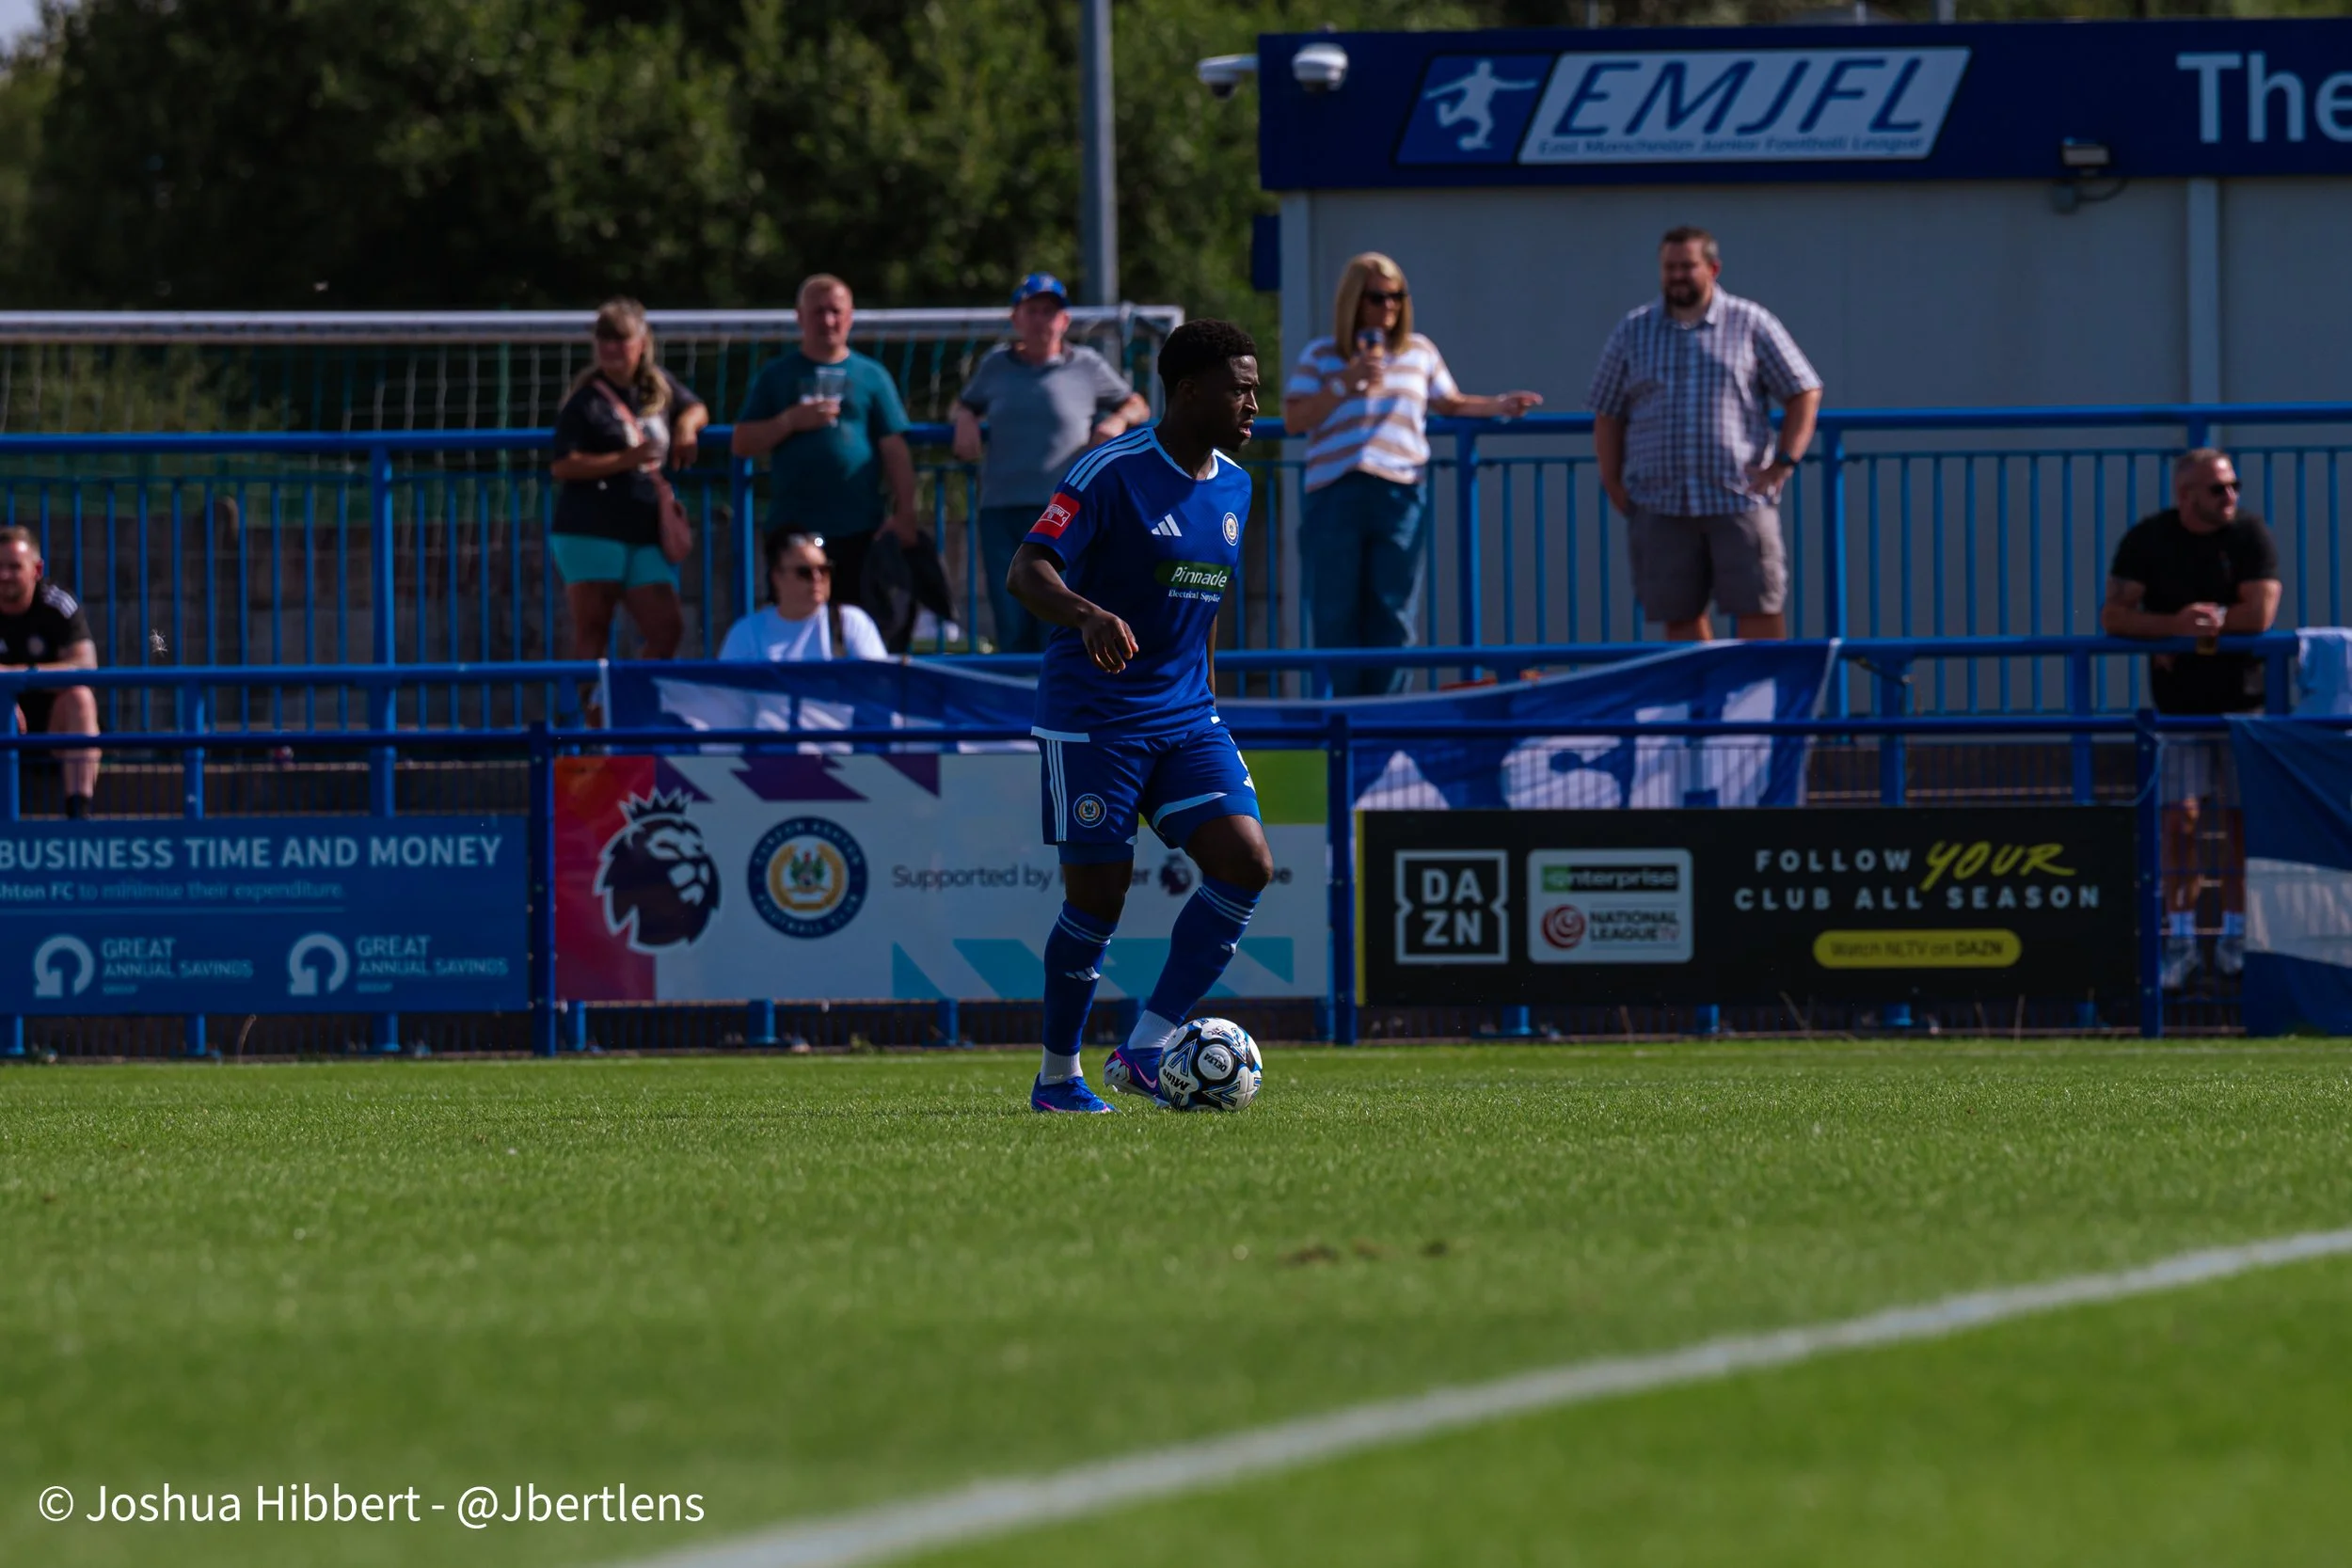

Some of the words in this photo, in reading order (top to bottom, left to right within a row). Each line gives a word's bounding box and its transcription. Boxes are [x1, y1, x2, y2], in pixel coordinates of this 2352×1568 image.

[1552, 57, 1923, 135] EMJFL
[2175, 50, 2352, 143] The
[1852, 136, 1924, 155] League
[0, 836, 175, 870] BUSINESS
[183, 836, 273, 869] TIME
[280, 834, 358, 868] AND
[369, 832, 503, 867] MONEY
[1755, 848, 1912, 873] FOLLOW
[892, 863, 1018, 892] Supported
[1025, 863, 1054, 893] by
[1547, 867, 1677, 890] enterprise
[51, 880, 75, 901] FC
[79, 881, 99, 901] to
[187, 879, 229, 900] their
[1734, 887, 1833, 911] CLUB
[1854, 886, 1924, 910] ALL
[1946, 884, 2100, 910] SEASON
[1589, 911, 1677, 925] NATIONAL
[101, 938, 177, 958] GREAT
[354, 936, 431, 957] GREAT
[1830, 942, 1880, 958] Watch
[1931, 942, 1952, 956] on
[1955, 940, 2004, 957] DAZN
[103, 961, 176, 979] ANNUAL
[180, 959, 254, 979] SAVINGS
[358, 959, 429, 976] ANNUAL
[435, 958, 509, 976] SAVINGS
[1203, 1052, 1228, 1073] DELTA
